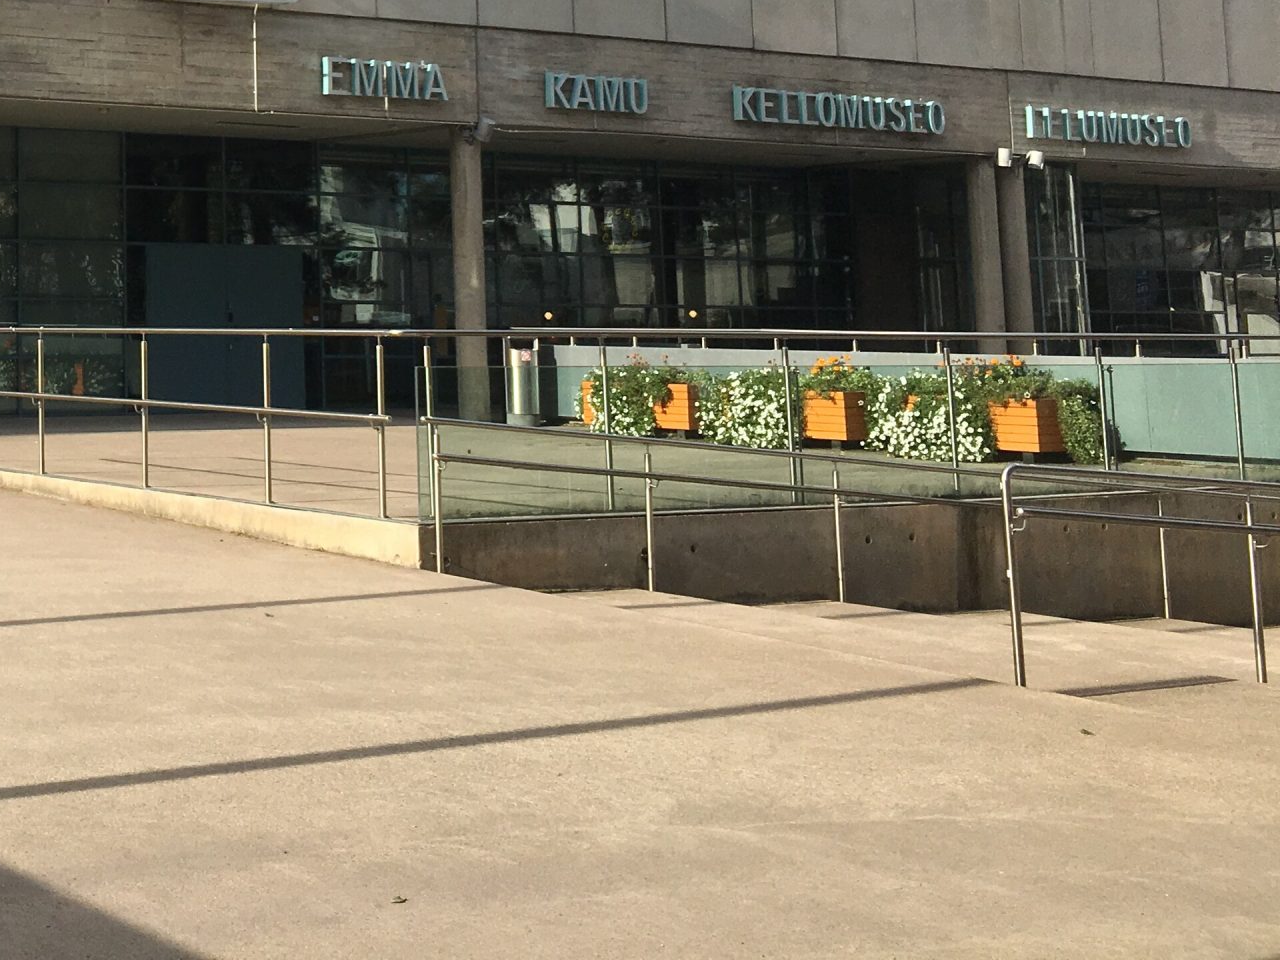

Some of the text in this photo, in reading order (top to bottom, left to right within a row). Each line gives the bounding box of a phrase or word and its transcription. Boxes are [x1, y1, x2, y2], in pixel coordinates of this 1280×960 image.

[322, 55, 448, 101] EMMA
[544, 70, 648, 114] KAMU
[732, 84, 946, 135] KELLOMUSEO
